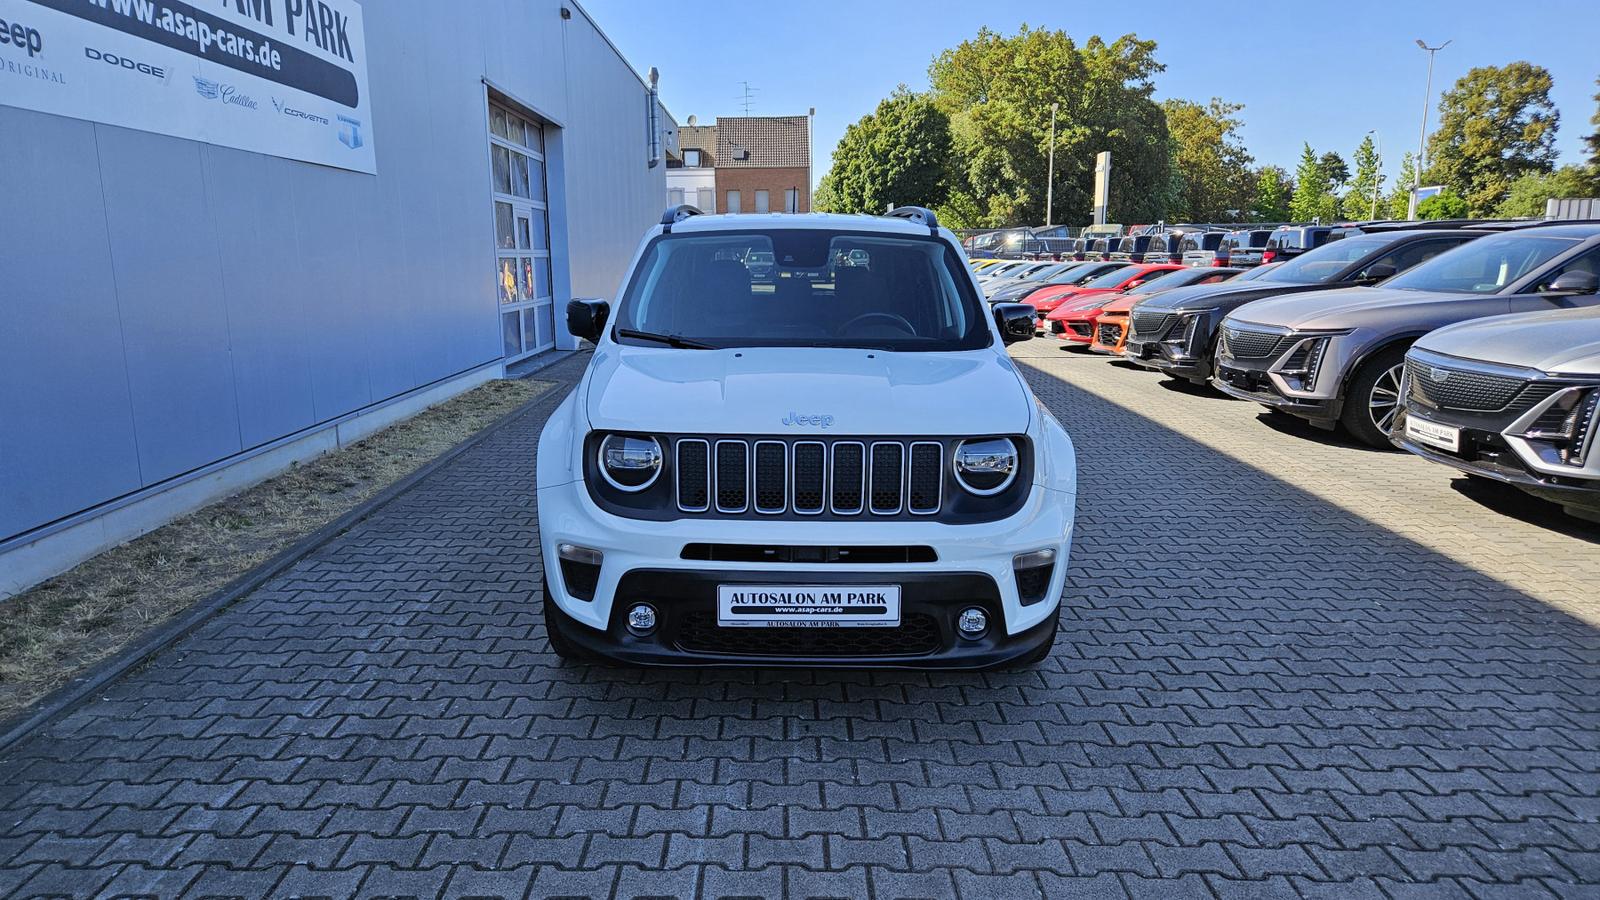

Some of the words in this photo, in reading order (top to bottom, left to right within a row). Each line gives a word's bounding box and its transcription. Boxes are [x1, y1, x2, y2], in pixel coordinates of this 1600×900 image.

[88, 0, 281, 70] ww.asap-cars.de
[284, 0, 354, 64] PARK
[84, 47, 165, 79] DODGE
[219, 83, 258, 111] Cadillac
[284, 107, 329, 126] CORVETTE
[781, 411, 834, 429] Jeep
[730, 592, 816, 605] AUTOSALON
[820, 592, 842, 604] AM
[847, 592, 887, 605] PARK
[775, 606, 844, 614] www.asap-cars.de
[766, 620, 807, 628] AUTOSALON
[808, 620, 819, 628] AM
[820, 620, 840, 628] PARK
